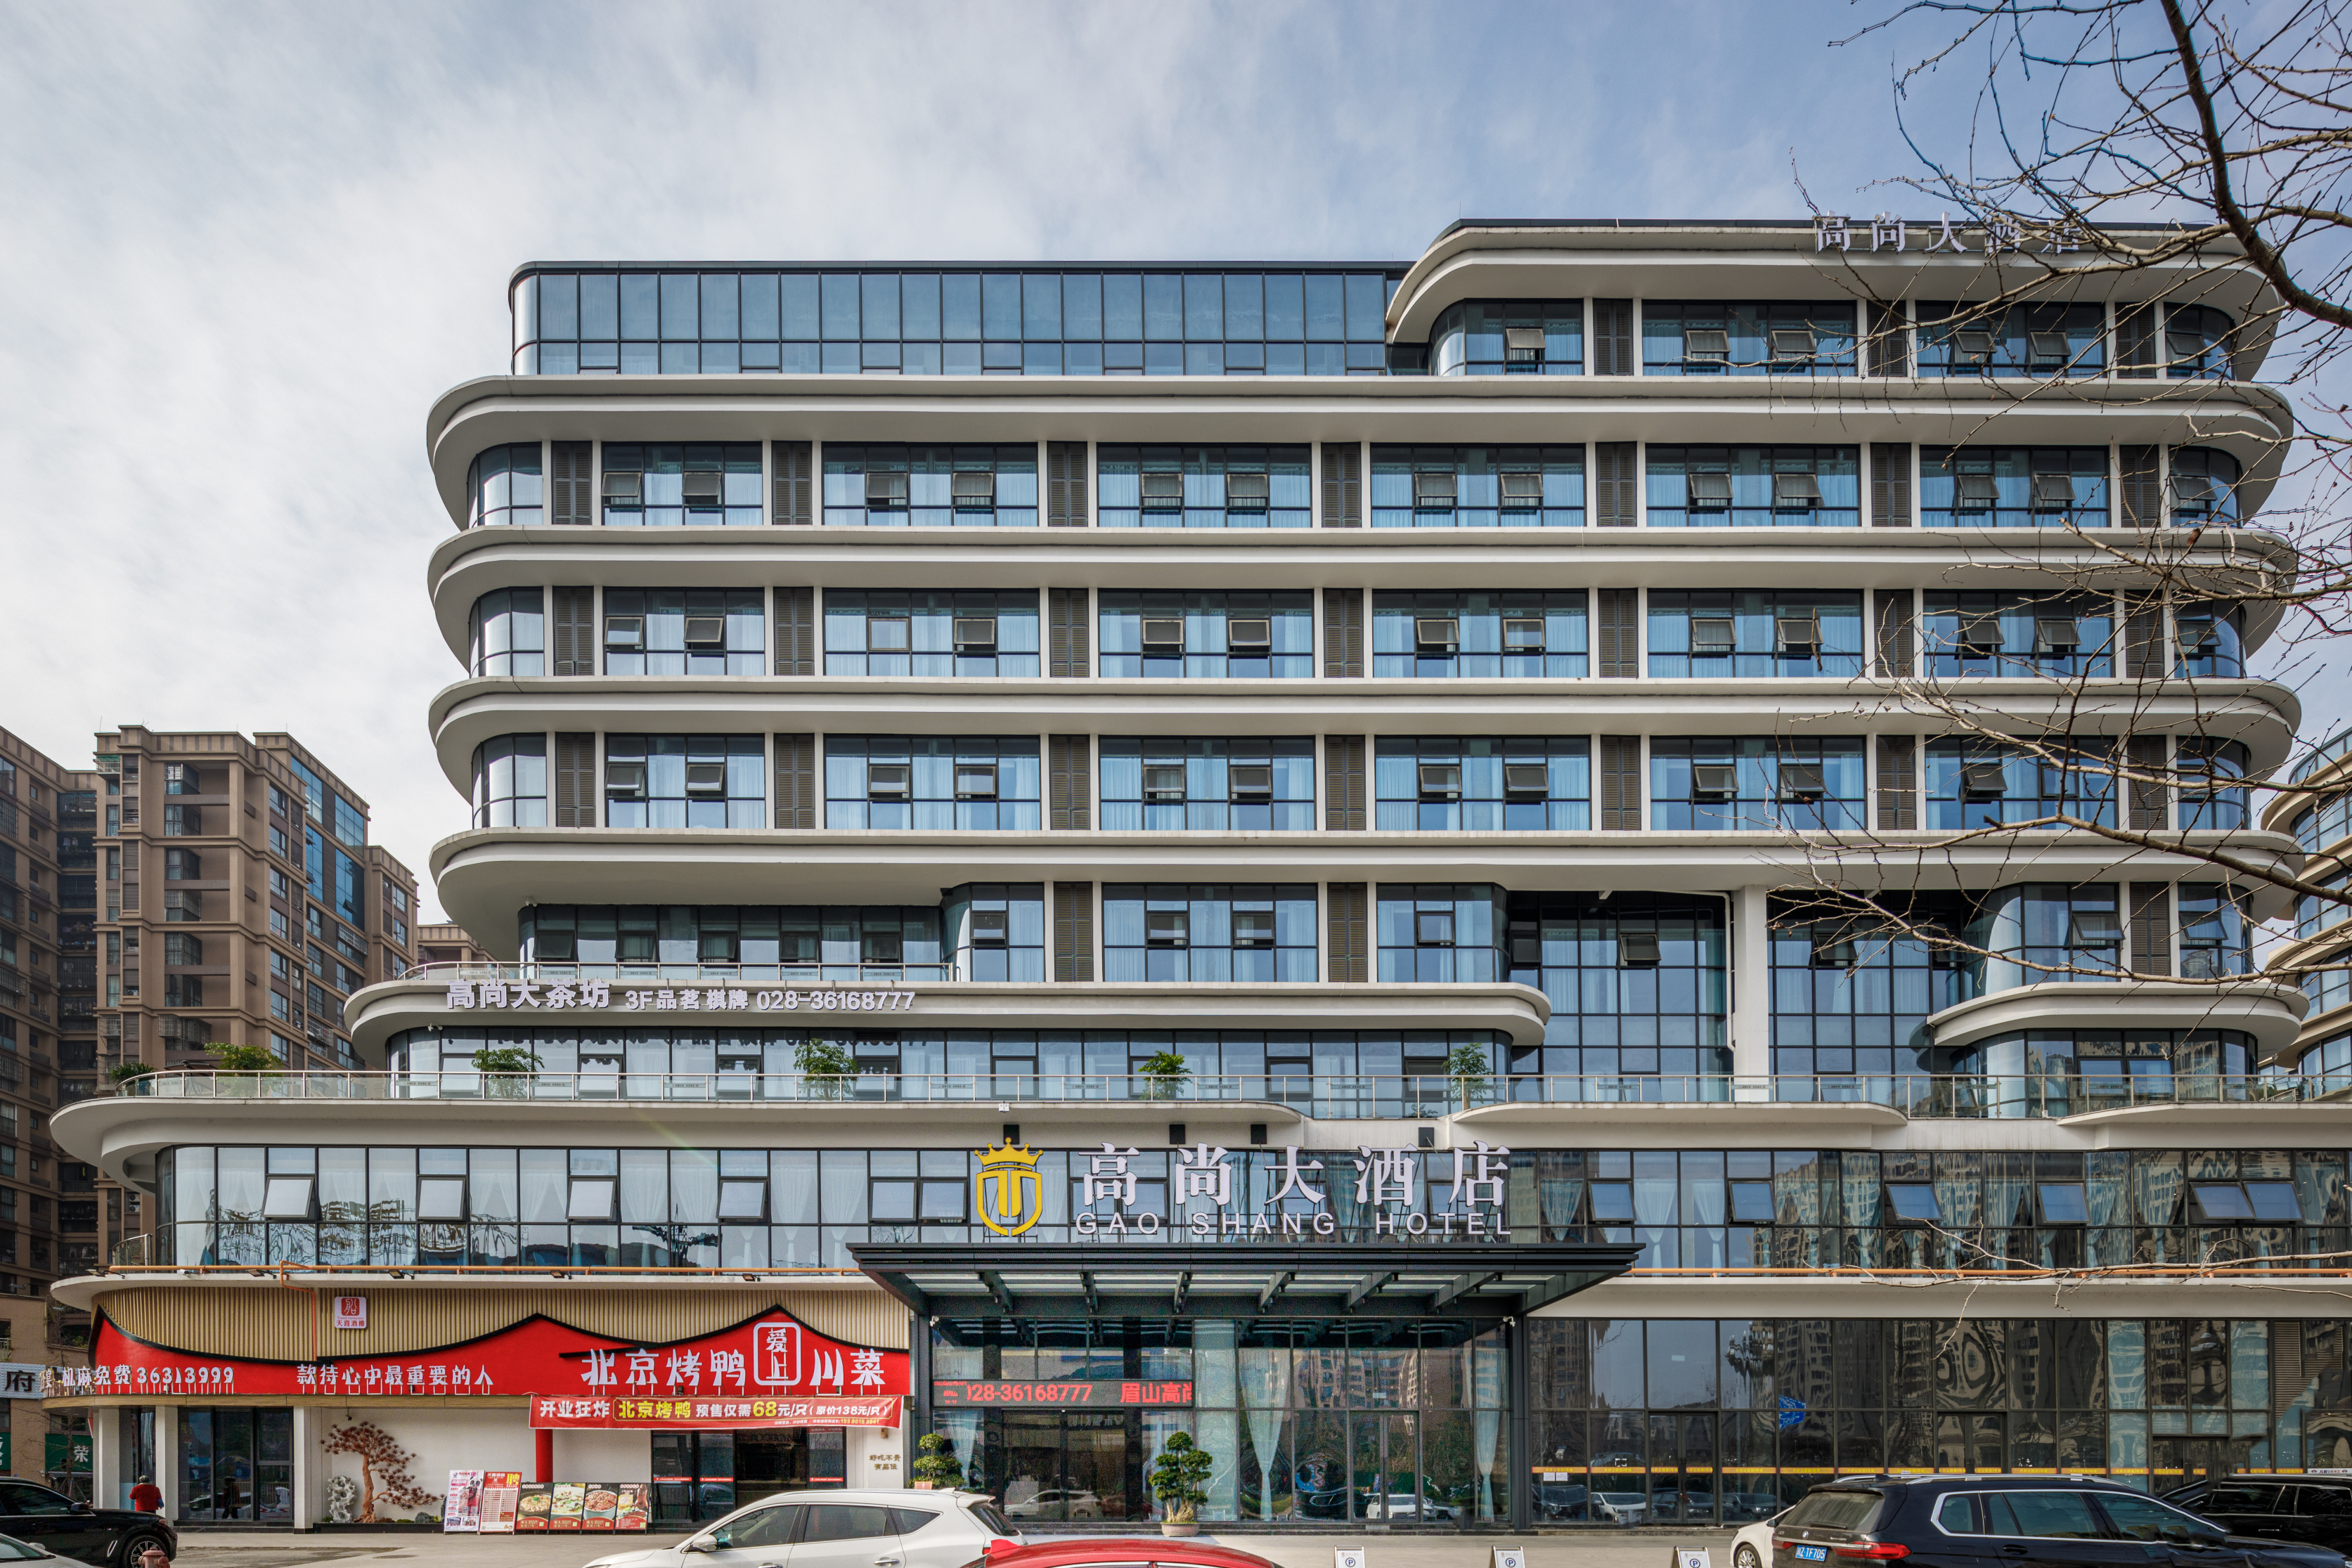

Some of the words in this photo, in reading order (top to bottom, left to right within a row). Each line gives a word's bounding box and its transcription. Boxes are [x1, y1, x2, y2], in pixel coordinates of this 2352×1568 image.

[446, 979, 610, 1009] 高尚大茶坊
[756, 991, 916, 1011] 028-36168777
[1078, 1141, 1511, 1207] 高尚大酒店
[1077, 1212, 1159, 1235] GAO
[1191, 1212, 1335, 1236] SHANG
[1376, 1212, 1511, 1236] HOTEL
[767, 1328, 788, 1380] 爱上
[62, 1365, 131, 1387] 机麻免费
[137, 1367, 234, 1385] 36313999
[297, 1364, 493, 1386] 款待心中最重要的人
[581, 1348, 746, 1387] 北京烤鸭
[810, 1348, 886, 1386] 川菜
[4, 1371, 35, 1392] 府
[540, 1401, 610, 1418] 开业狂炸
[619, 1401, 691, 1418] 北京烤鸭
[74, 1445, 89, 1462] 荣
